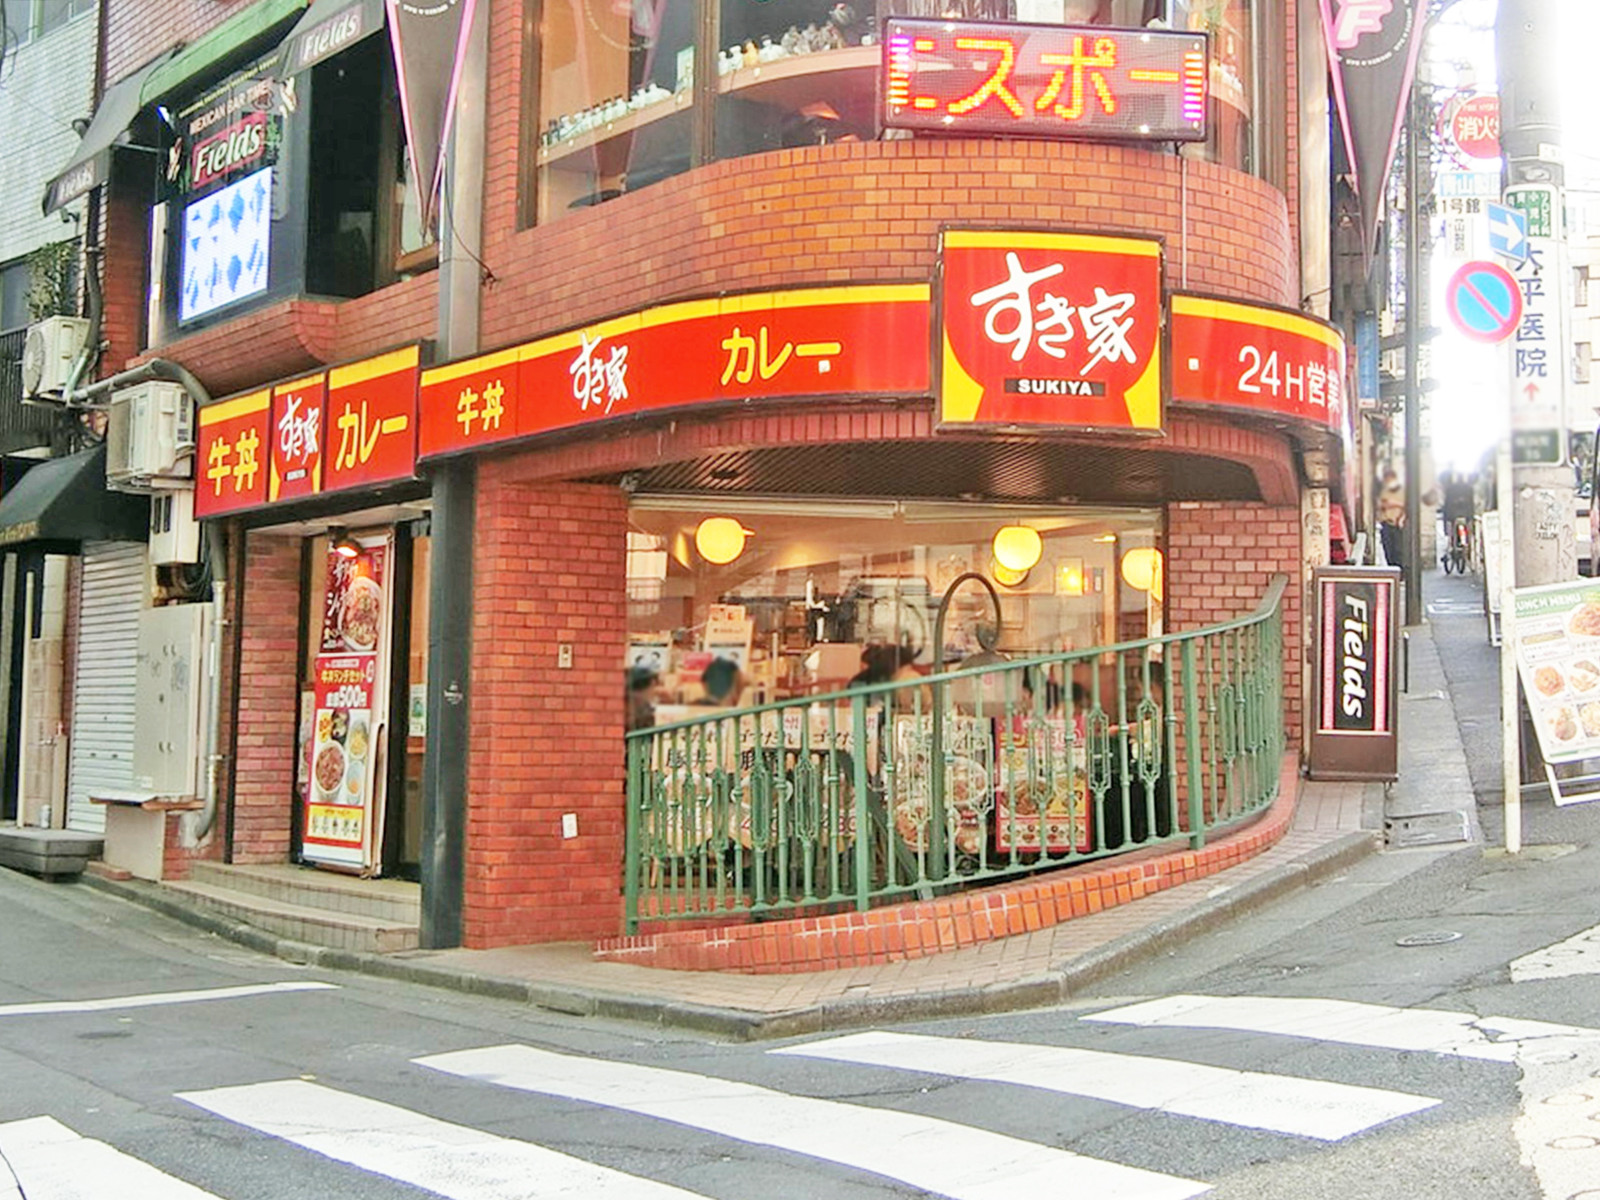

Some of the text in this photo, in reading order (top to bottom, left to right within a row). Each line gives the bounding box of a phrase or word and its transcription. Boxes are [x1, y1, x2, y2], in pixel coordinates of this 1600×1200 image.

[303, 13, 359, 61] Fields
[193, 123, 263, 183] Fields
[970, 251, 1138, 376] すき家
[570, 331, 629, 414] すき家
[720, 326, 841, 386] カレー
[1017, 378, 1093, 396] SUKIYA
[278, 393, 320, 466] すき家
[335, 400, 408, 472] カレー
[456, 379, 505, 436] 牛丼
[207, 428, 260, 497] 牛丼
[1342, 594, 1370, 719] Fields
